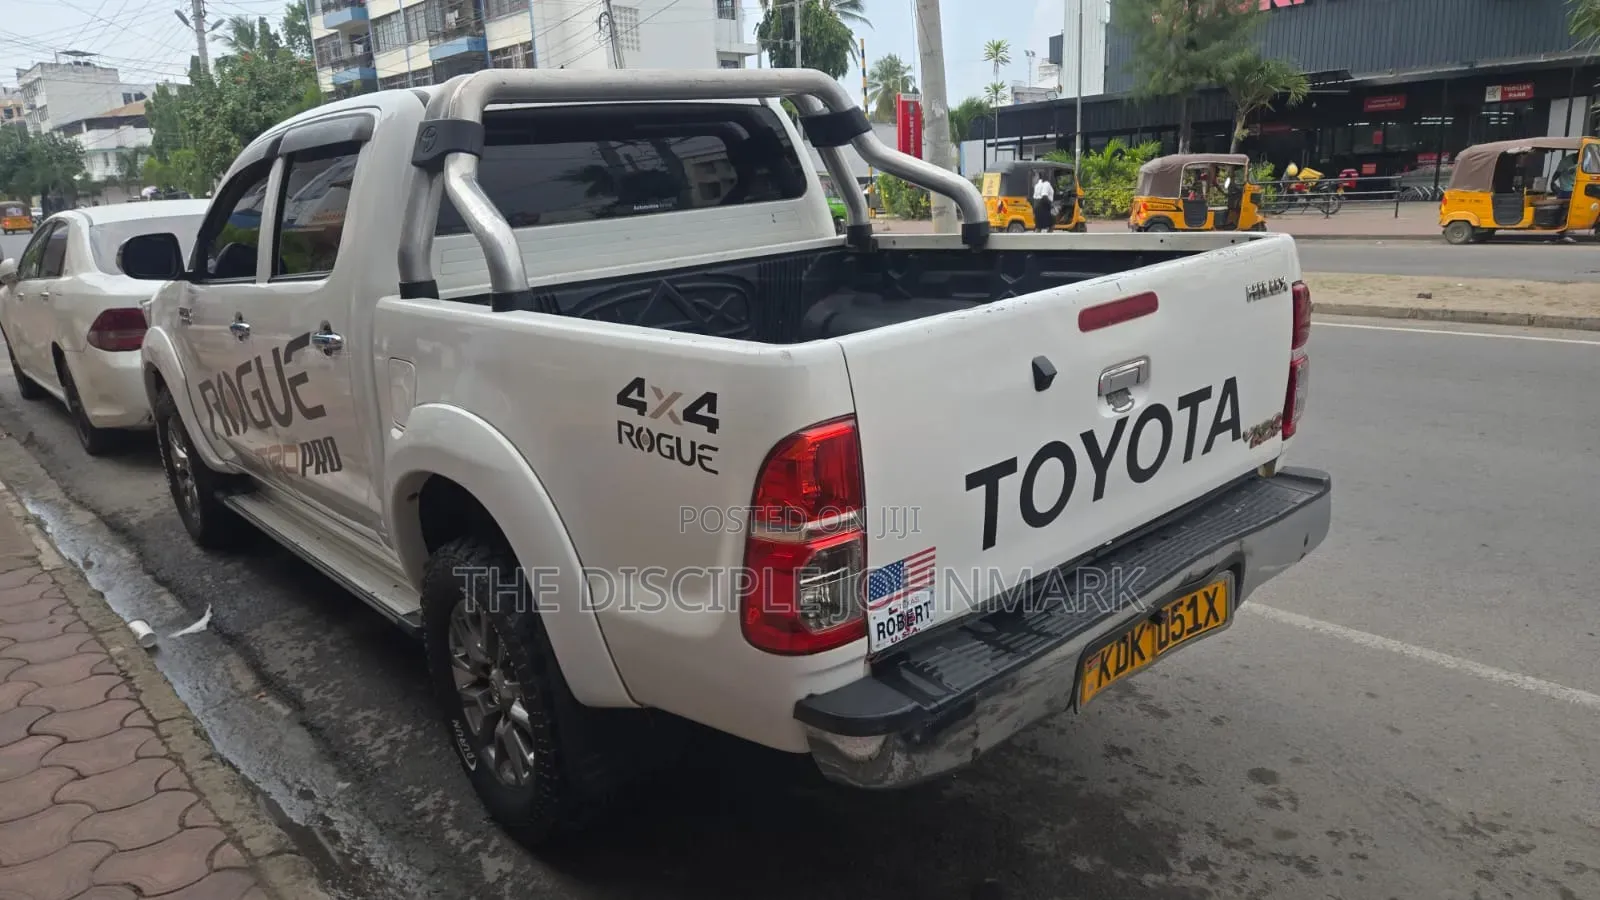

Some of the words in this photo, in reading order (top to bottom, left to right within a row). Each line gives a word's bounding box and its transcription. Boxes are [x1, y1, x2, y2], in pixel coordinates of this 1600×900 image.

[198, 332, 327, 440] ROGUE
[617, 419, 720, 476] ROGUE
[965, 376, 1242, 551] TOYOTA
[876, 600, 932, 641] ROBERT
[1096, 621, 1147, 689] KDK
